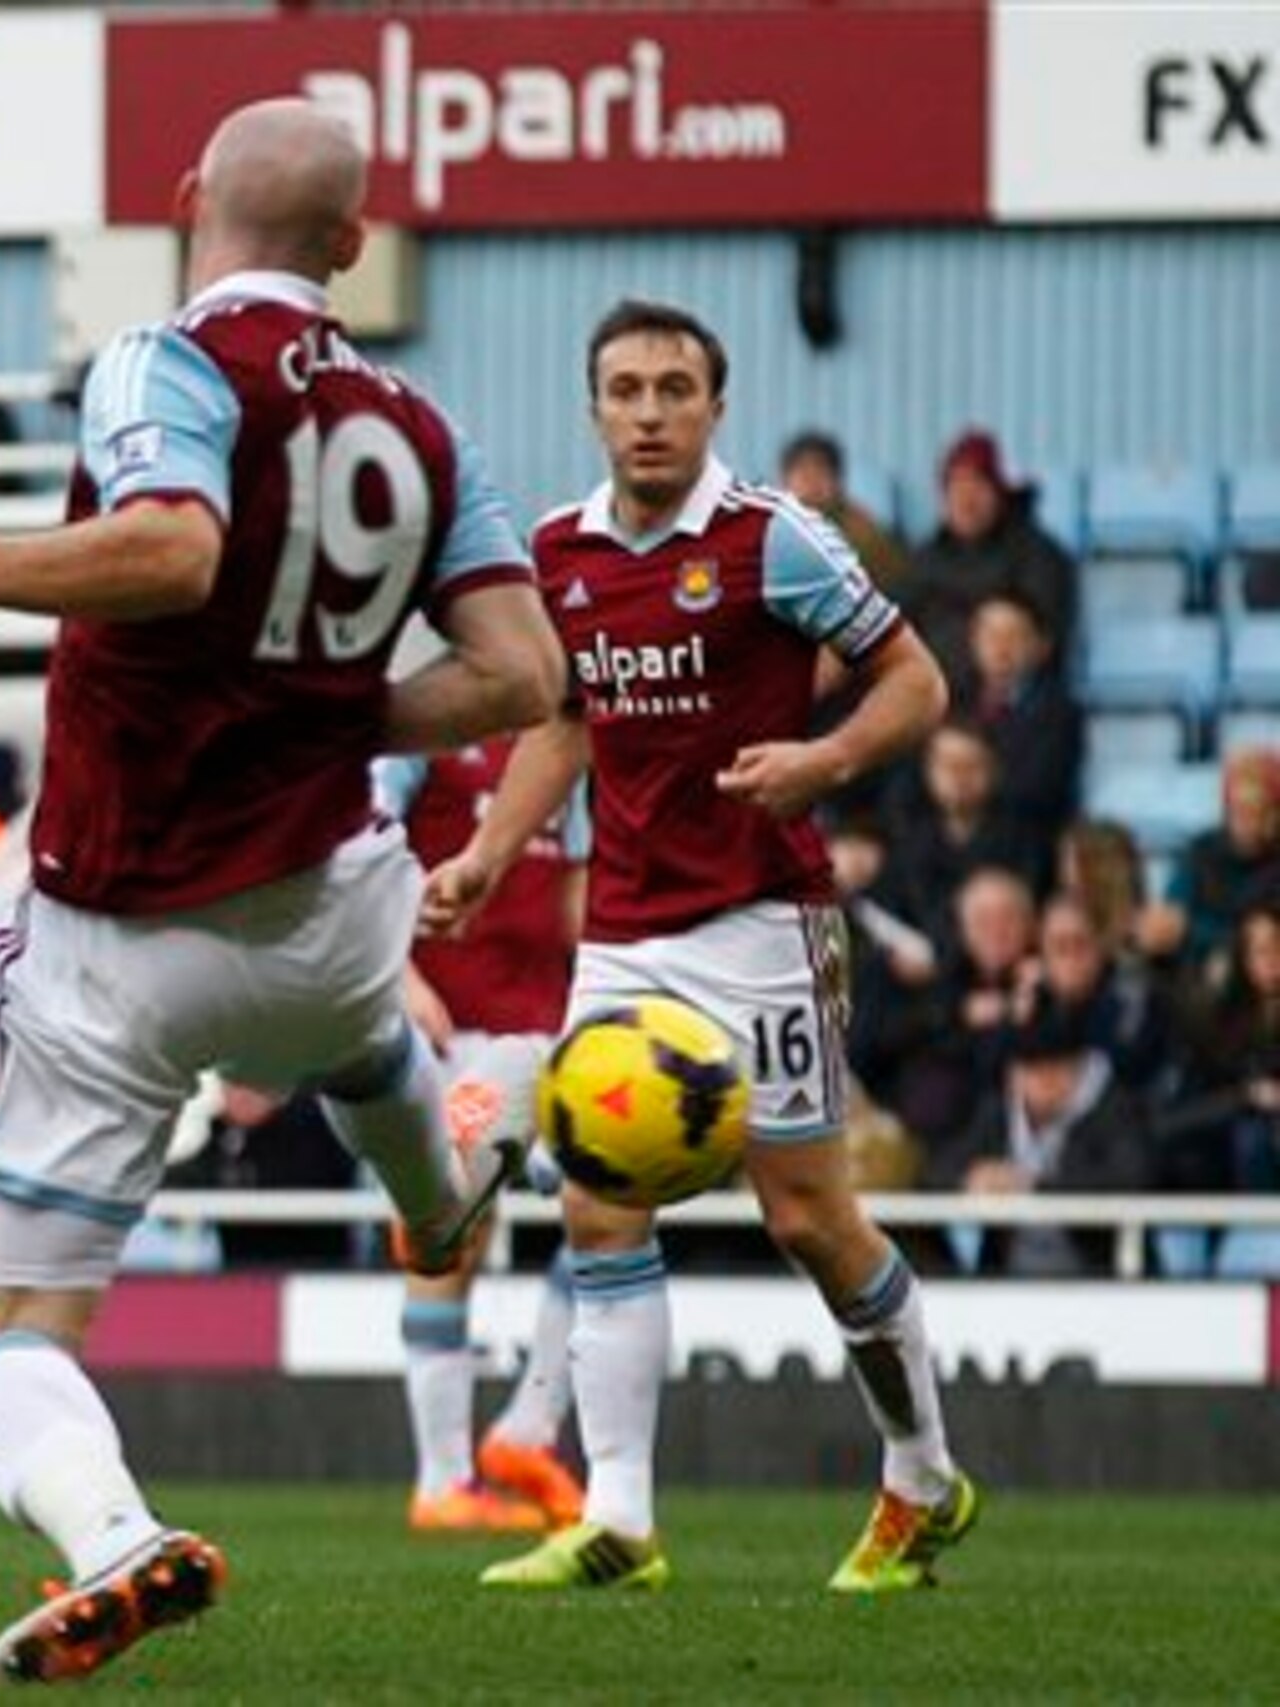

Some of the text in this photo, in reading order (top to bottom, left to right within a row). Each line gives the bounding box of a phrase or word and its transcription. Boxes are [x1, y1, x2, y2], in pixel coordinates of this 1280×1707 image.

[1143, 57, 1267, 146] FX
[252, 410, 432, 660] 19
[575, 631, 705, 696] alpari
[752, 1005, 813, 1085] 16
